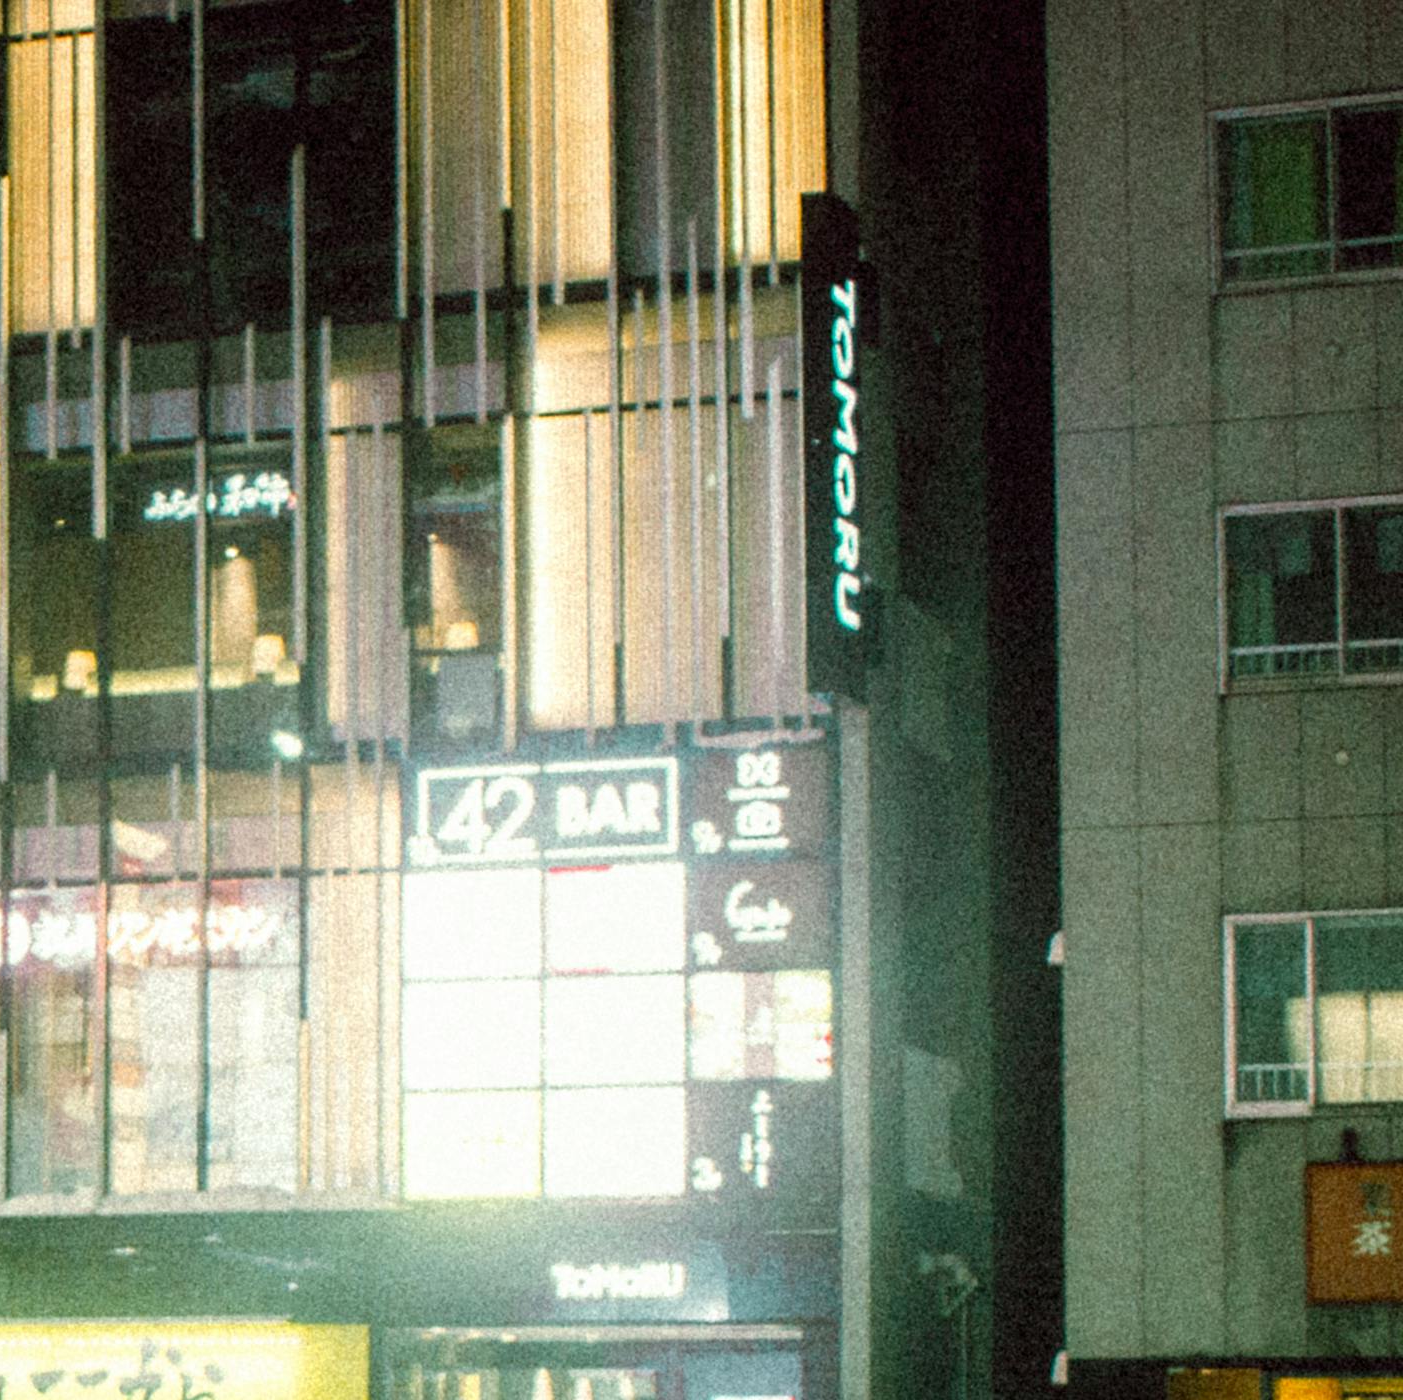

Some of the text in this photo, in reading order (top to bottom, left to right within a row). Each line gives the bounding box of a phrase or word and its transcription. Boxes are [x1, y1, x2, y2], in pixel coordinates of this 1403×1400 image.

[831, 278, 862, 631] TOMORU
[435, 774, 536, 854] 42
[555, 781, 660, 837] BAR
